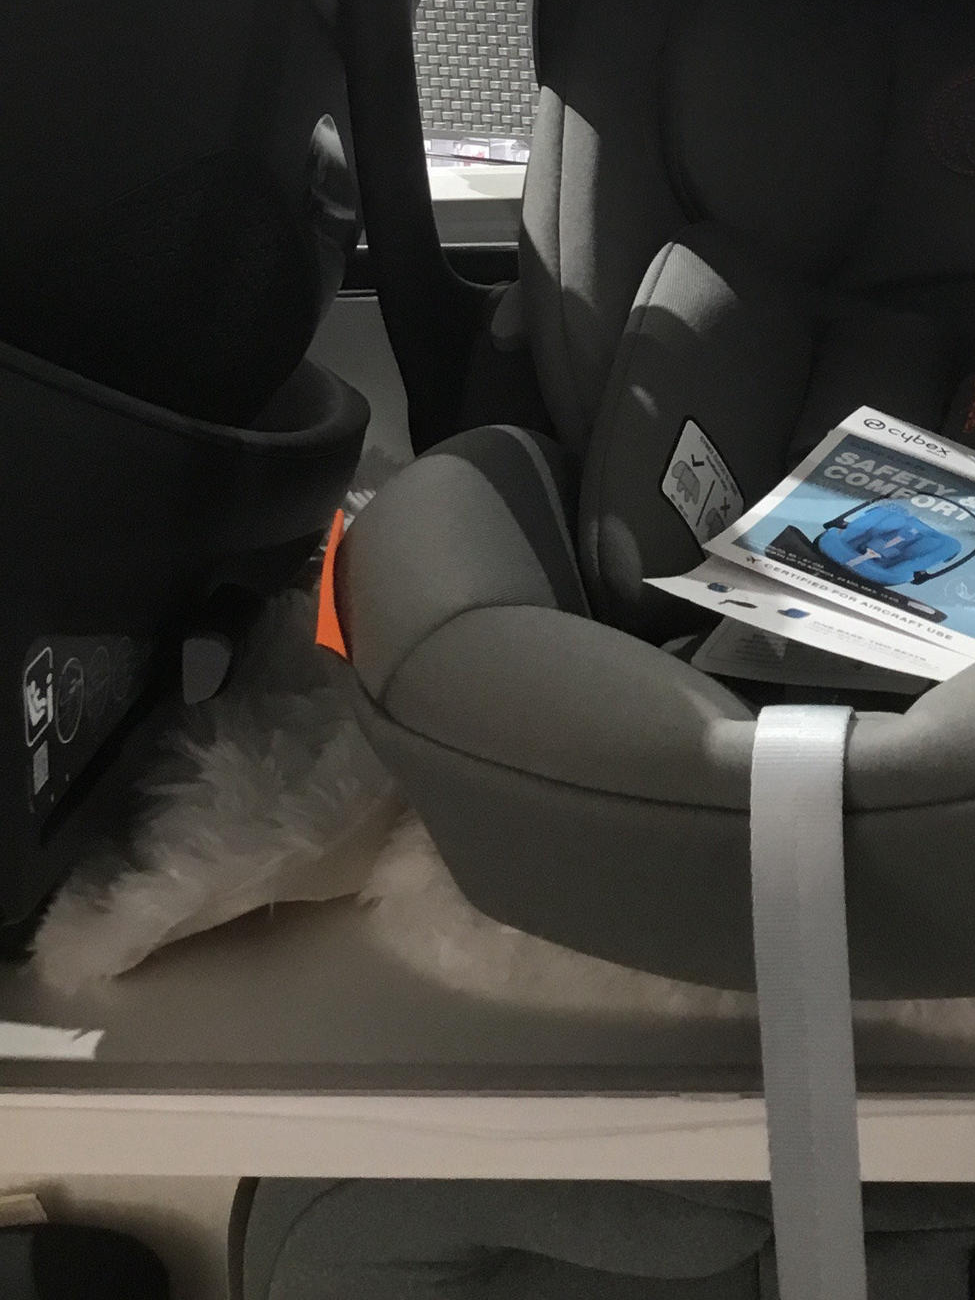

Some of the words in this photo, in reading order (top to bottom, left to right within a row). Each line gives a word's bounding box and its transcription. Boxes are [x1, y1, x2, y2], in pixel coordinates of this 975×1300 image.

[888, 428, 951, 457] cybex
[834, 452, 957, 496] SAFETY
[764, 562, 829, 592] CERTIFIED
[831, 588, 858, 603] FOR
[860, 600, 924, 628] AIRCRAFT
[926, 626, 954, 641] USE
